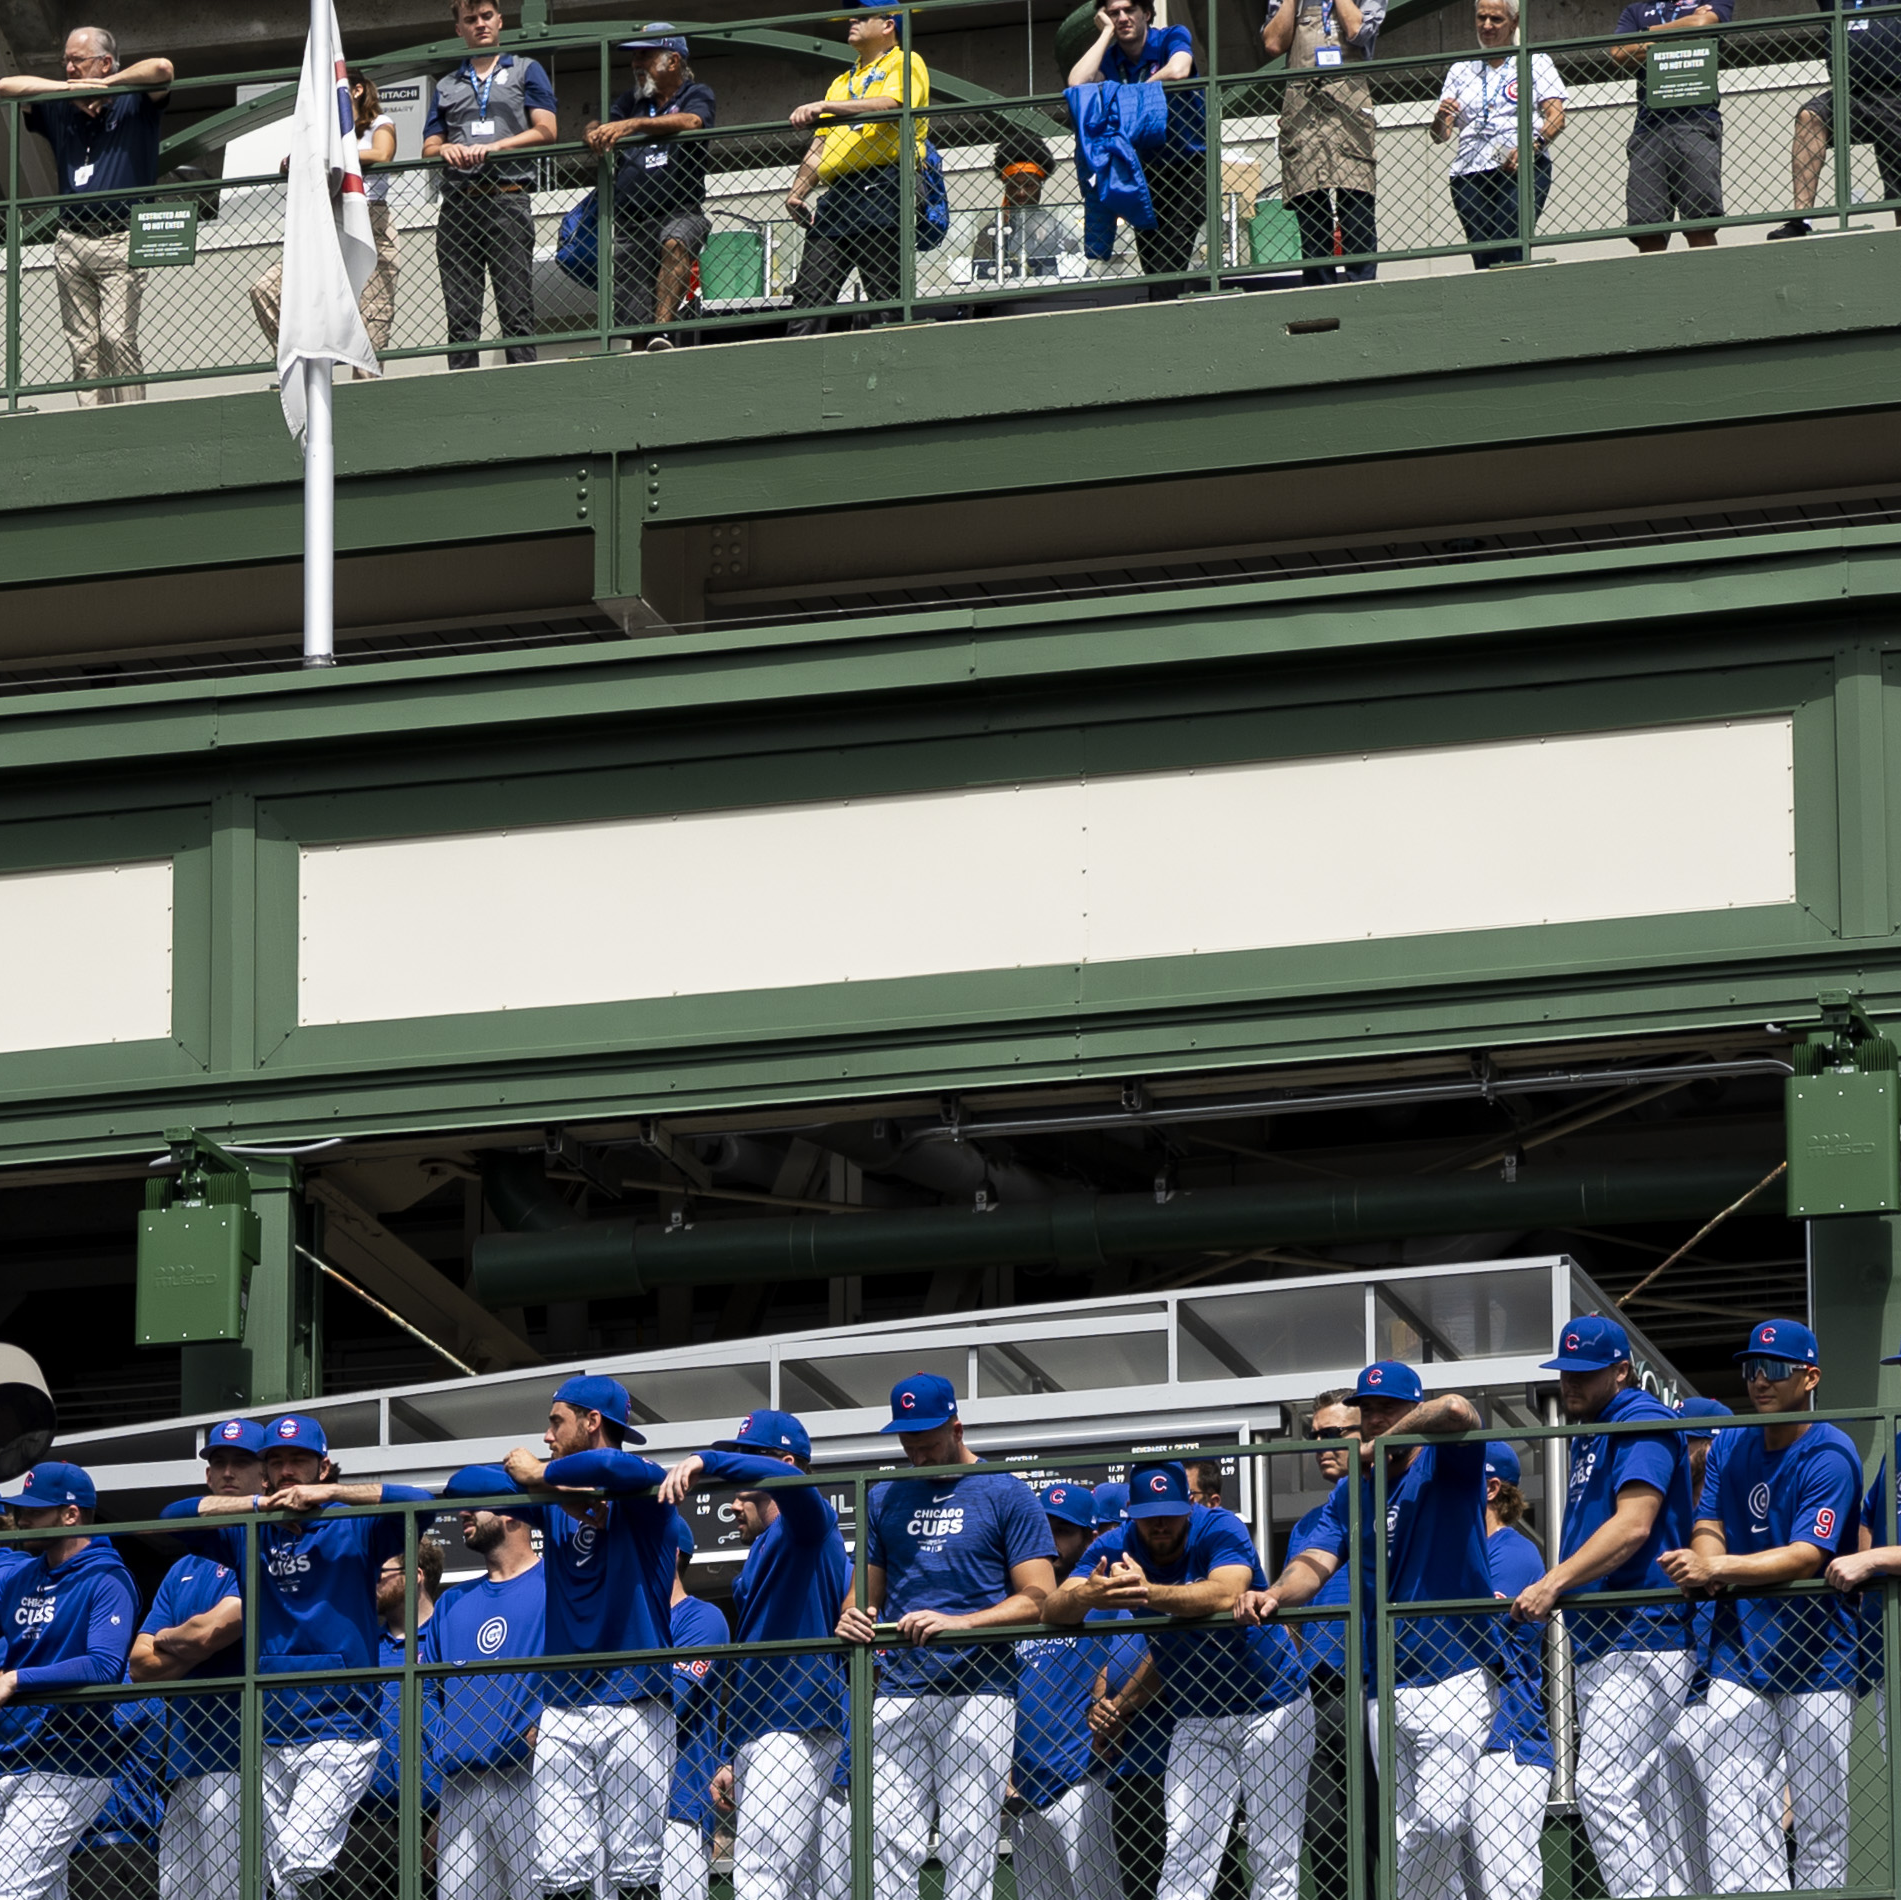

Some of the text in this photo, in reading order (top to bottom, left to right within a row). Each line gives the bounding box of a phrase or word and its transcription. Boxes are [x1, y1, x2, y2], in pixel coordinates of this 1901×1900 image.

[1653, 49, 1711, 62] RESTRICTED AREA
[1659, 59, 1705, 71] DO NOT ENTER
[378, 87, 418, 100] HITACHI
[138, 210, 191, 222] RESTRICTED AREA
[142, 222, 152, 231] DO
[152, 221, 164, 230] NOT
[1565, 1333, 1580, 1351] C
[1760, 1327, 1777, 1343] C
[1368, 1369, 1383, 1386] C
[901, 1392, 916, 1409] C
[1150, 1475, 1168, 1493] C
[1050, 1489, 1067, 1505] C
[913, 1507, 965, 1520] CHICAGO
[907, 1518, 965, 1537] CUBS
[1814, 1507, 1836, 1539] 9
